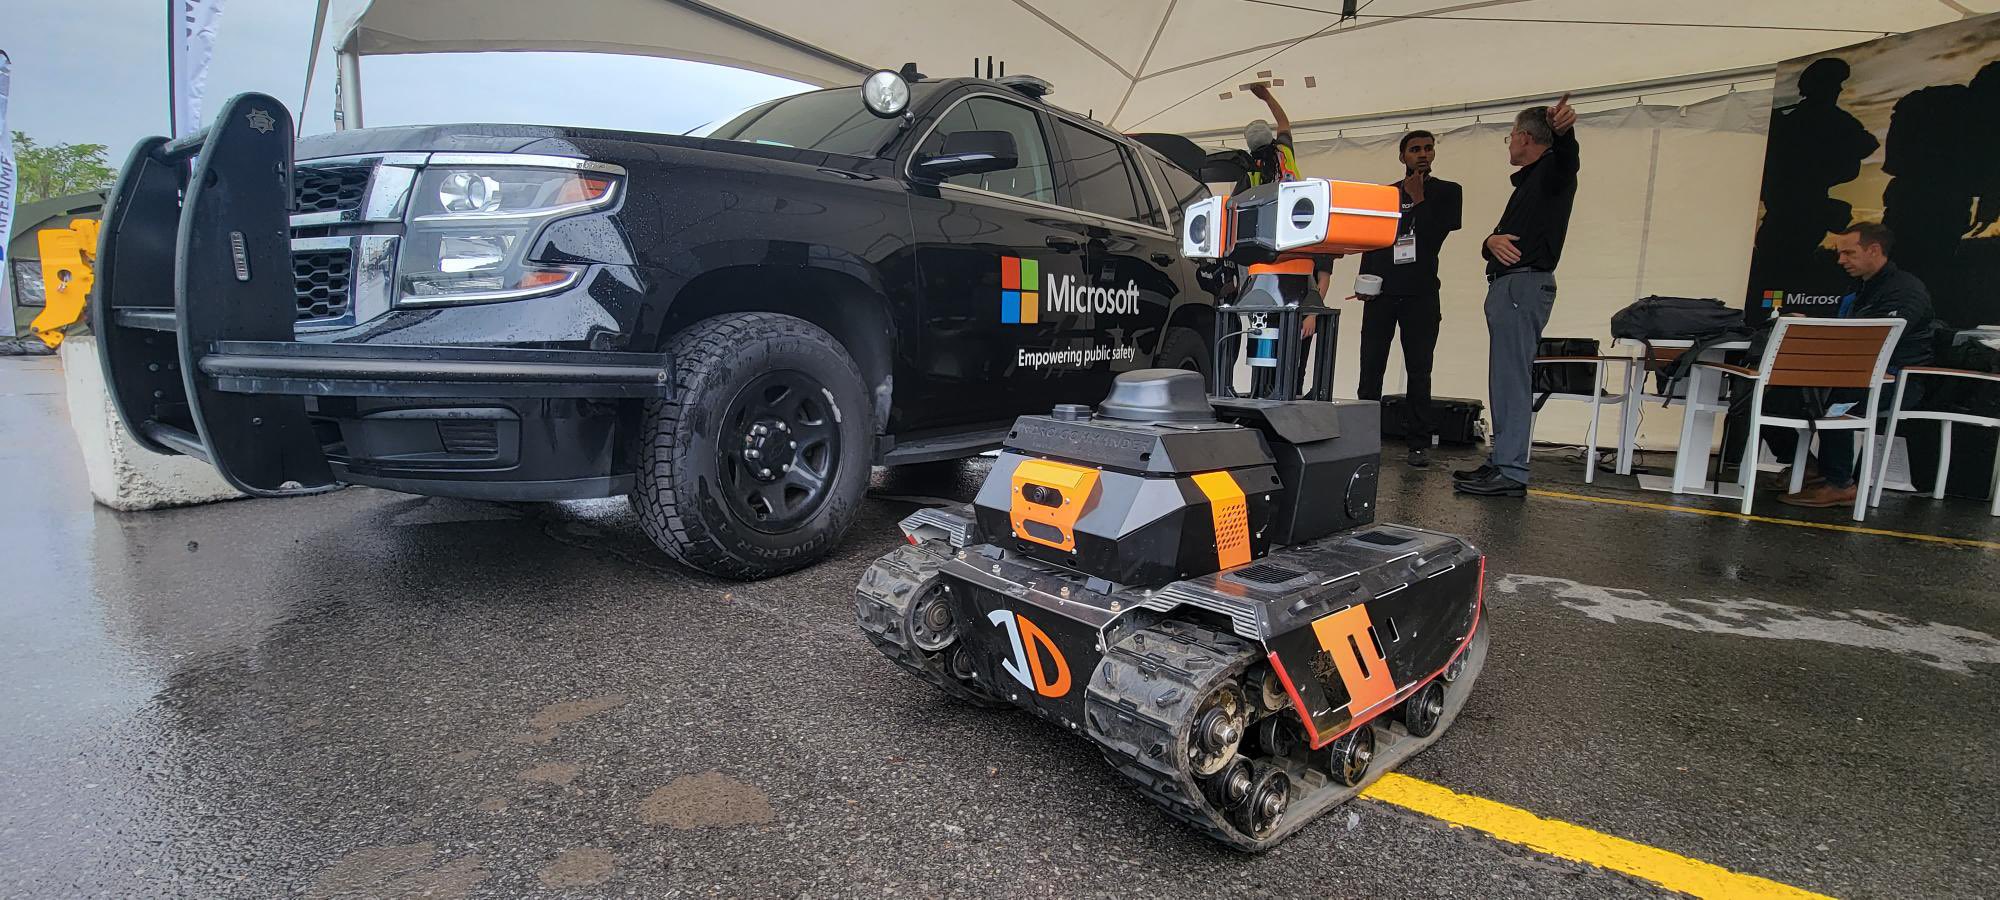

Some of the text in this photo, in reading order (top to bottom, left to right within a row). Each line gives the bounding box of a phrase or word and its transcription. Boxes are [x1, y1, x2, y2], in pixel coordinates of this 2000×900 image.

[1047, 273, 1139, 315] Microsoft
[1018, 344, 1136, 370] Empowering public safety
